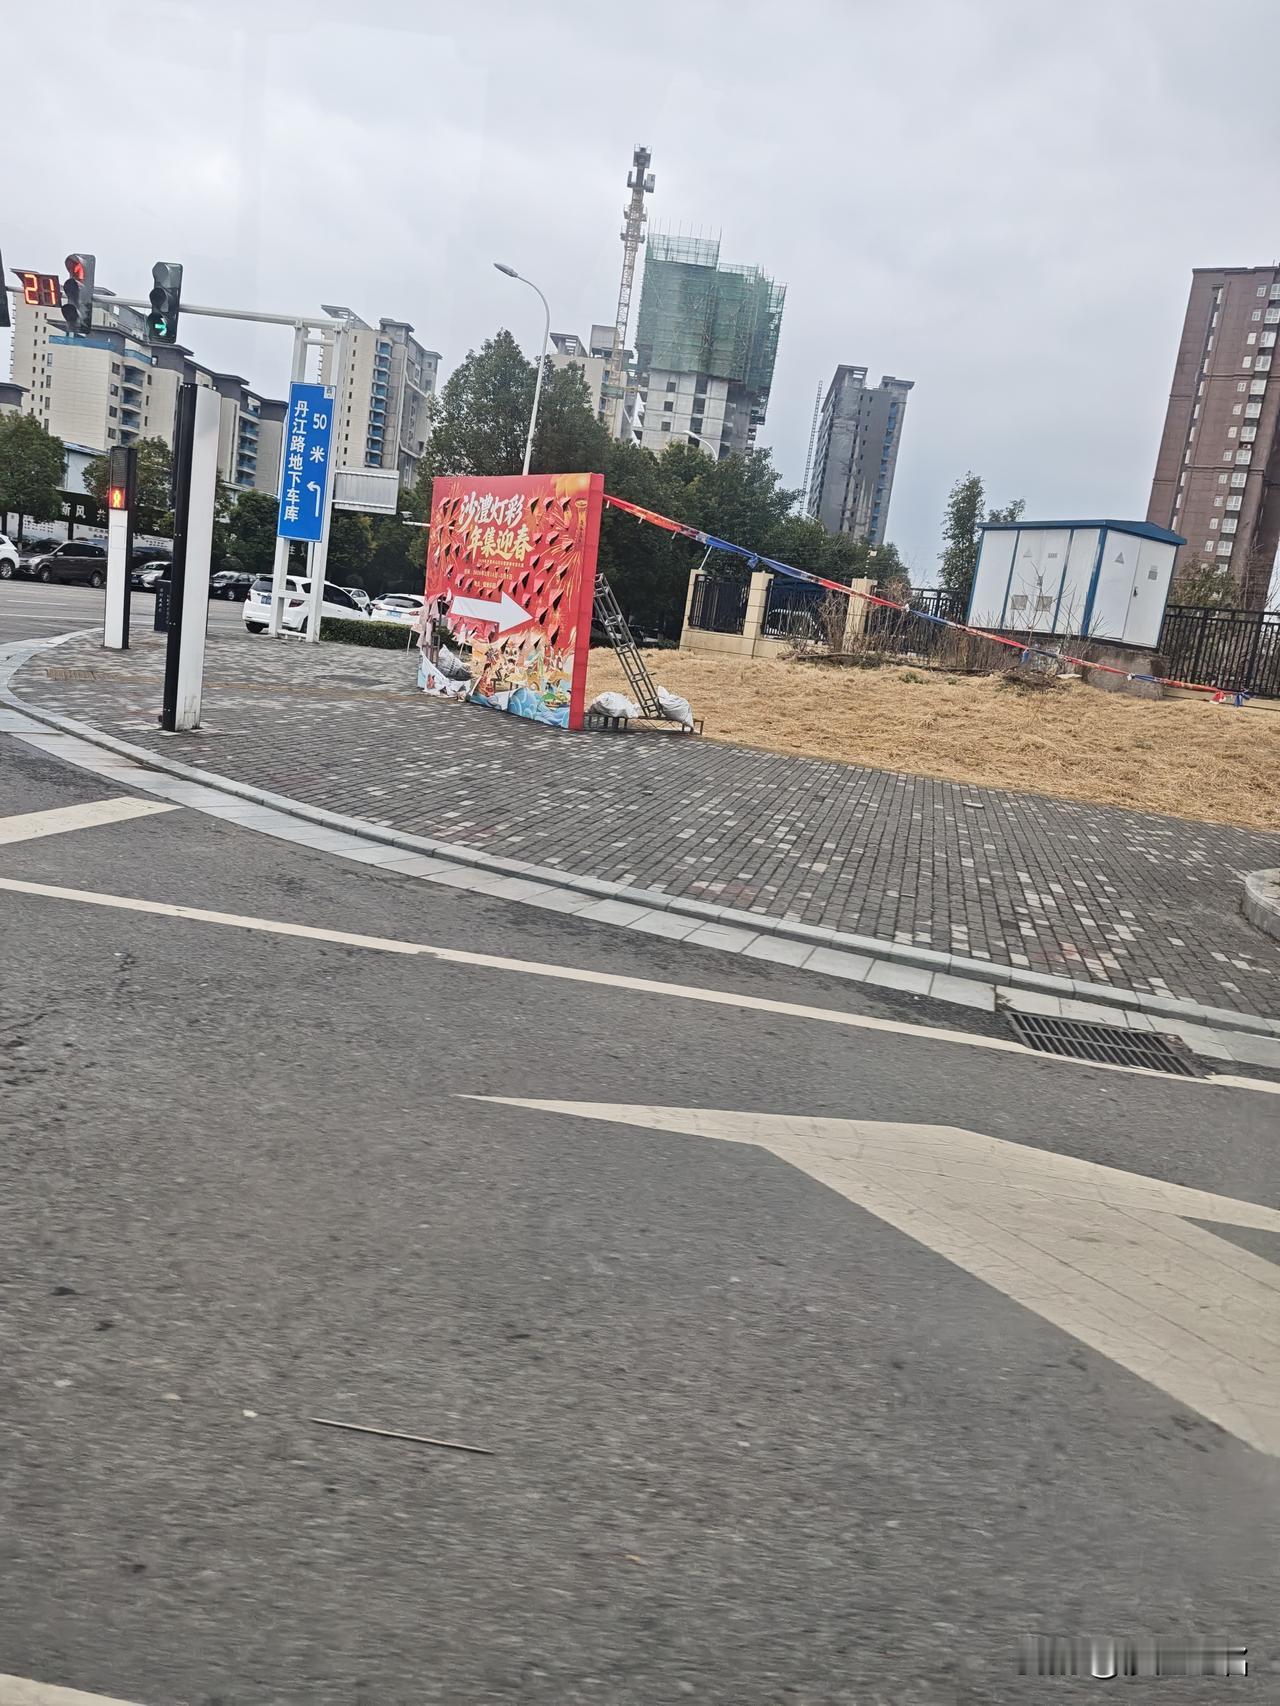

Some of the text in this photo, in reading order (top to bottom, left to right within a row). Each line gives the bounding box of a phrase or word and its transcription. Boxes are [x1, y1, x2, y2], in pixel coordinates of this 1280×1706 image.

[24, 274, 56, 305] 21
[283, 400, 309, 523] 丹江路地下车库
[458, 491, 525, 533] 沙澧灯彩
[467, 524, 535, 562] 年集迎春
